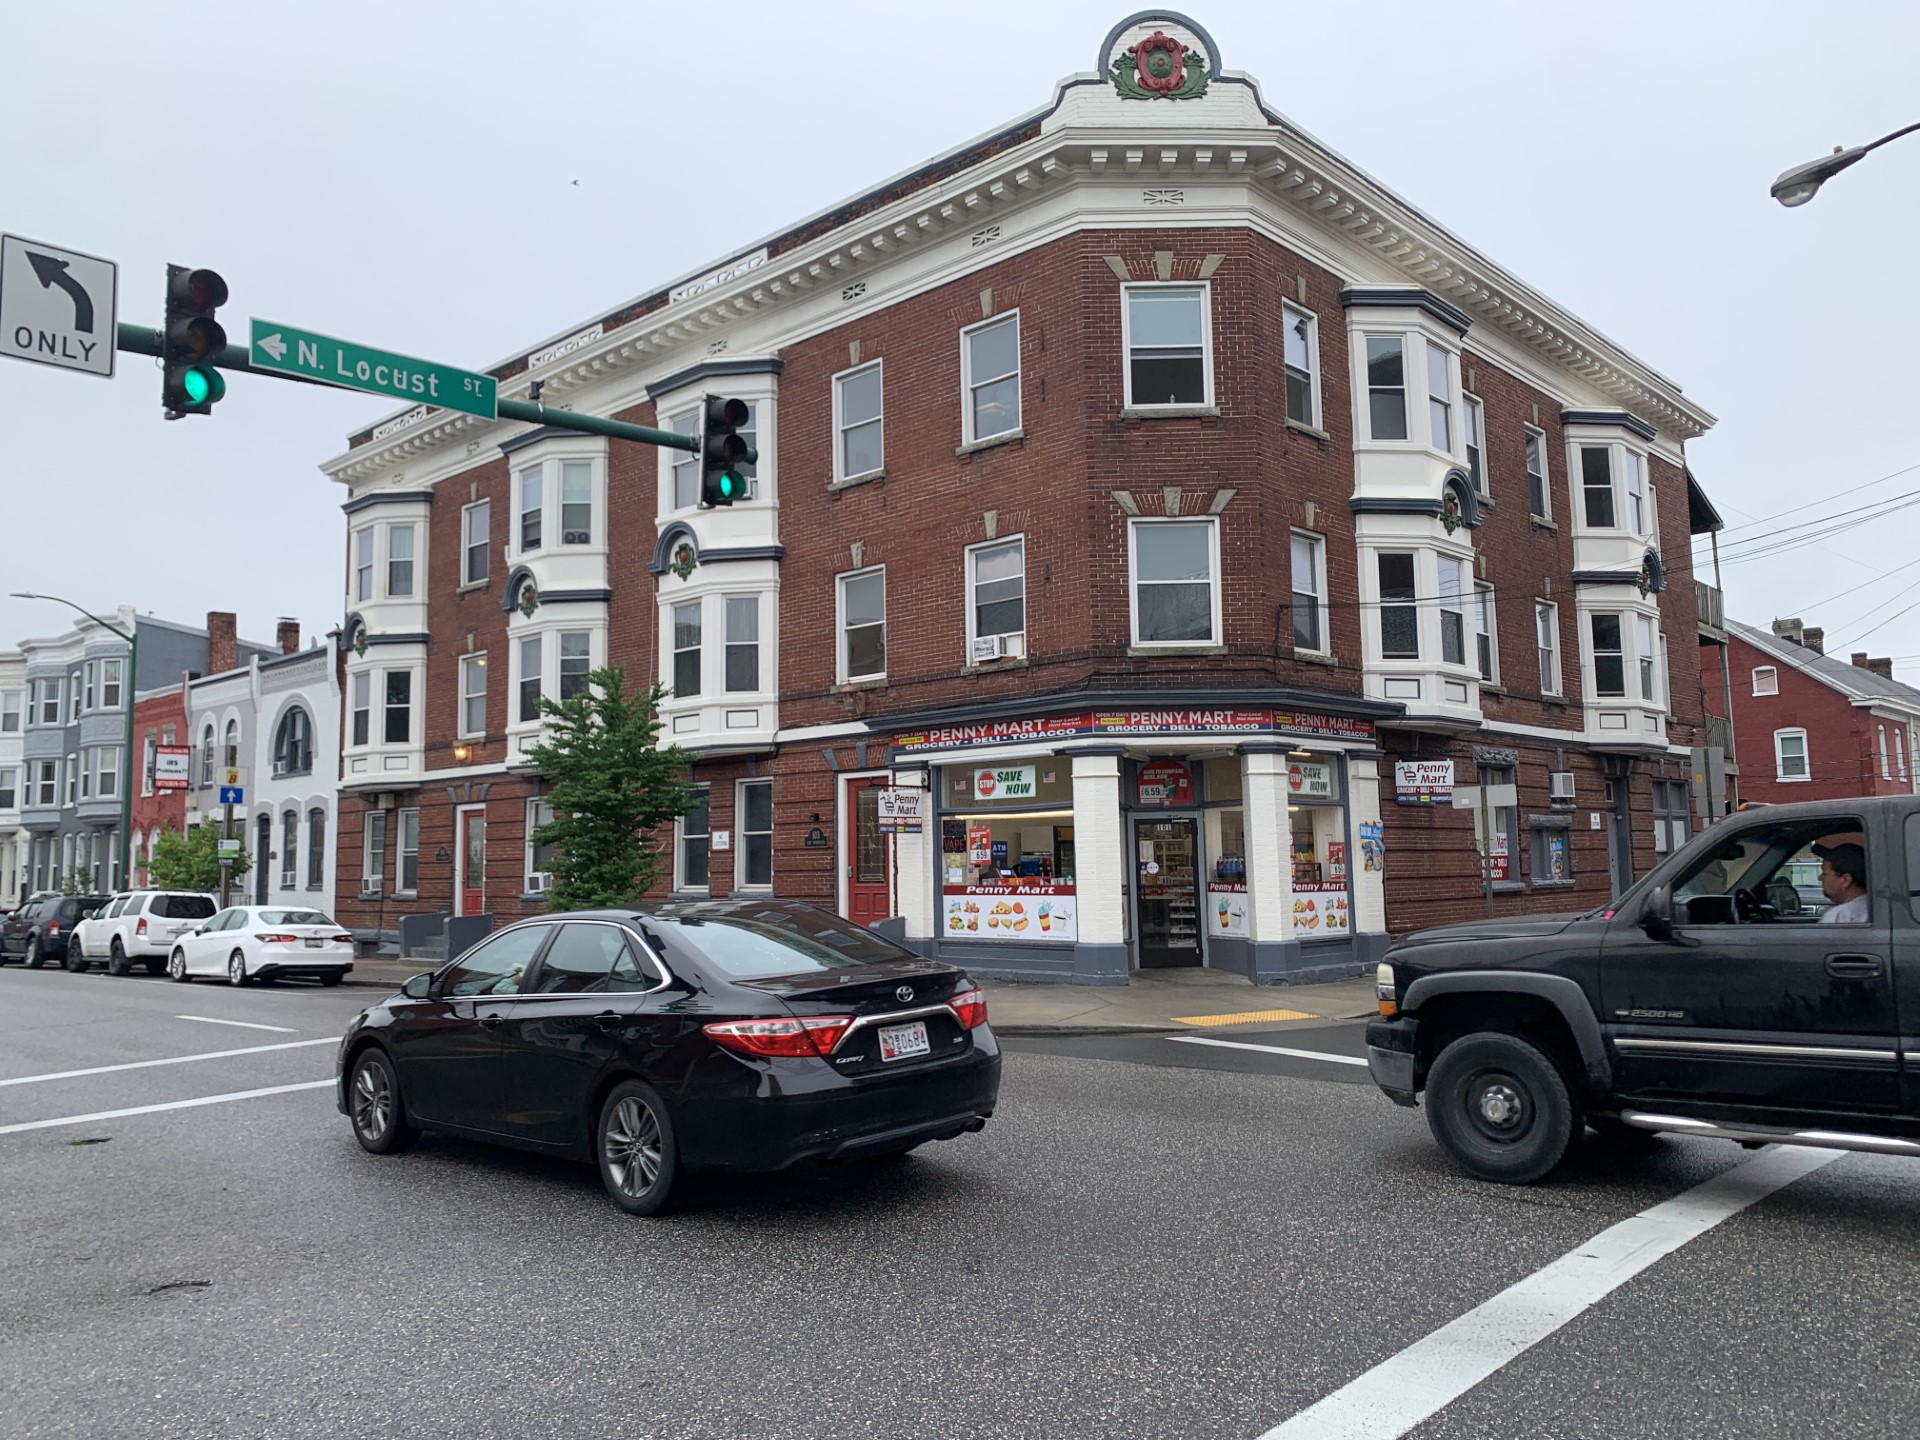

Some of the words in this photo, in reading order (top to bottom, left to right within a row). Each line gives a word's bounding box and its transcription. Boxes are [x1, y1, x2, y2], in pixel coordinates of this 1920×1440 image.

[15, 326, 97, 362] ONLY
[298, 339, 325, 370] N.
[337, 349, 439, 397] Locust
[1130, 711, 1184, 725] PENNY
[1189, 711, 1233, 724] MART
[1295, 712, 1327, 727] PENNY
[1329, 716, 1354, 730] MART
[929, 724, 988, 742] PENNY
[993, 718, 1046, 735] MART
[1106, 724, 1161, 732] GROCERY
[1205, 723, 1259, 731] TOBACCO
[1280, 724, 1313, 732] GROCERY
[1338, 729, 1369, 738] TOBACCO
[905, 739, 962, 750] GROCERY
[972, 736, 1000, 744] DELI
[1011, 728, 1076, 740] TOBACCO
[1303, 767, 1321, 779] SAVE
[1417, 763, 1451, 774] Penny
[997, 770, 1023, 783] SAVE
[1289, 772, 1302, 783] STOP
[1420, 774, 1447, 784] Mart
[979, 779, 994, 789] STOP
[1005, 782, 1031, 795] NOW
[1310, 780, 1328, 792] NOW
[894, 794, 920, 805] Penny
[896, 805, 917, 815] Mart
[944, 839, 966, 851] VAPE
[992, 844, 1007, 852] ATM
[965, 885, 1012, 895] Penny
[1016, 885, 1055, 894] Mart
[1209, 883, 1232, 892] Penny
[1292, 883, 1319, 892] Penny
[1322, 882, 1345, 890] Mart
[1631, 1009, 1666, 1018] 2500
